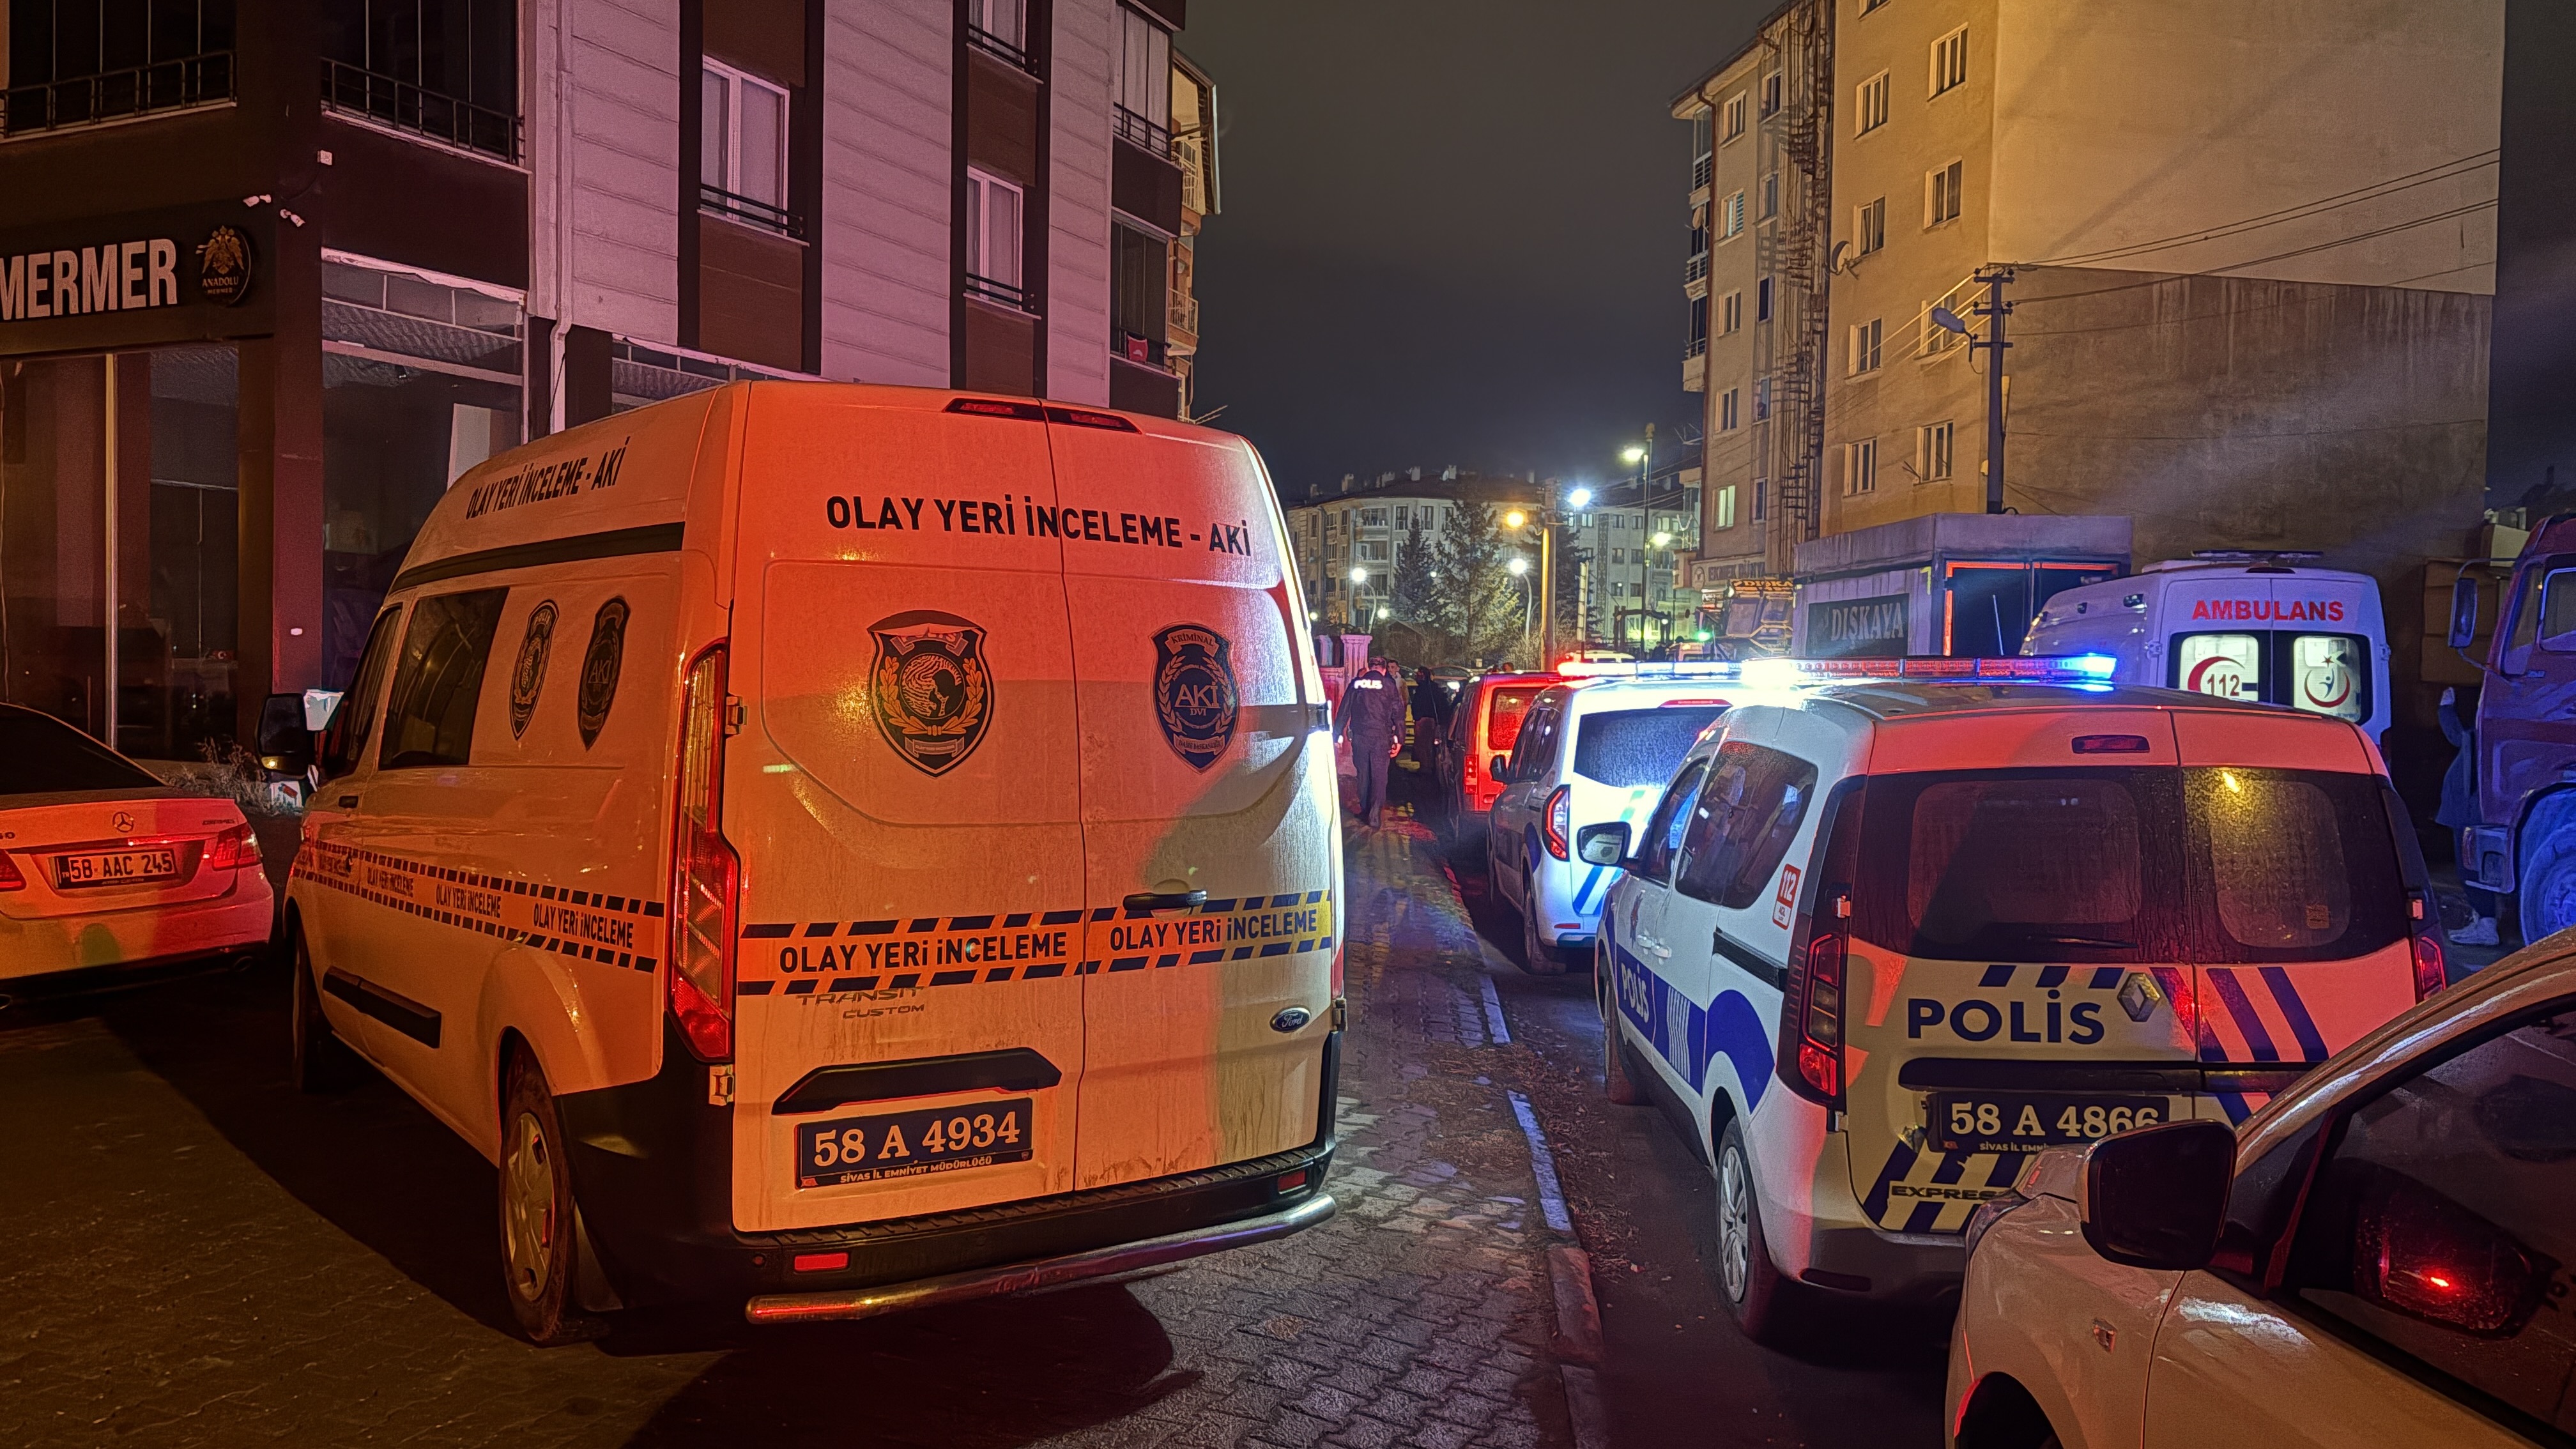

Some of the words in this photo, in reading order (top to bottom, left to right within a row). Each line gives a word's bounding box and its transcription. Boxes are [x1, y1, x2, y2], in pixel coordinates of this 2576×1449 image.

[0, 238, 178, 320] MERMER
[203, 275, 239, 288] ANADOLU
[466, 482, 498, 519] OLAY
[493, 464, 528, 512] YERİ
[519, 457, 588, 505] İNCELEME
[590, 436, 631, 490] AKİ
[827, 495, 924, 530] OLAY
[933, 494, 1017, 535] YERİ
[1024, 495, 1184, 549] İNCELEME
[1208, 519, 1252, 556] AKİ
[2191, 599, 2344, 622] AMBULANS
[1830, 602, 1905, 650] DIŞKAYA
[1171, 633, 1214, 647] KRİMİNAL
[1174, 681, 1220, 707] AKİ
[2207, 674, 2240, 696] 112
[70, 858, 93, 879] 58
[103, 855, 134, 877] AAC
[141, 852, 172, 874] 245
[436, 884, 452, 905] OLAY
[1780, 870, 1797, 901] 112
[533, 903, 557, 930] OLAY
[1110, 923, 1170, 951] OLAY
[779, 944, 857, 973] OLAY
[796, 986, 924, 1006] TRANSIT
[1621, 962, 1650, 1023] POLİS
[843, 1004, 925, 1019] CUSTOM
[1281, 1013, 1303, 1028] Ford
[1907, 988, 2105, 1045] POLİS
[1951, 1101, 2001, 1136] 58
[2013, 1105, 2046, 1136] A
[814, 1129, 865, 1167] 58
[877, 1124, 910, 1160] A
[922, 1111, 1020, 1153] 4934
[1979, 1141, 2009, 1151] SİVAS
[2011, 1142, 2020, 1151] İL
[839, 1170, 870, 1184] SİVAS
[873, 1169, 882, 1181] İL
[884, 1163, 928, 1179] EMNİYET
[930, 1156, 992, 1172] MÜDÜRLÜĞÜ
[1891, 1184, 2002, 1201] EXPRES
